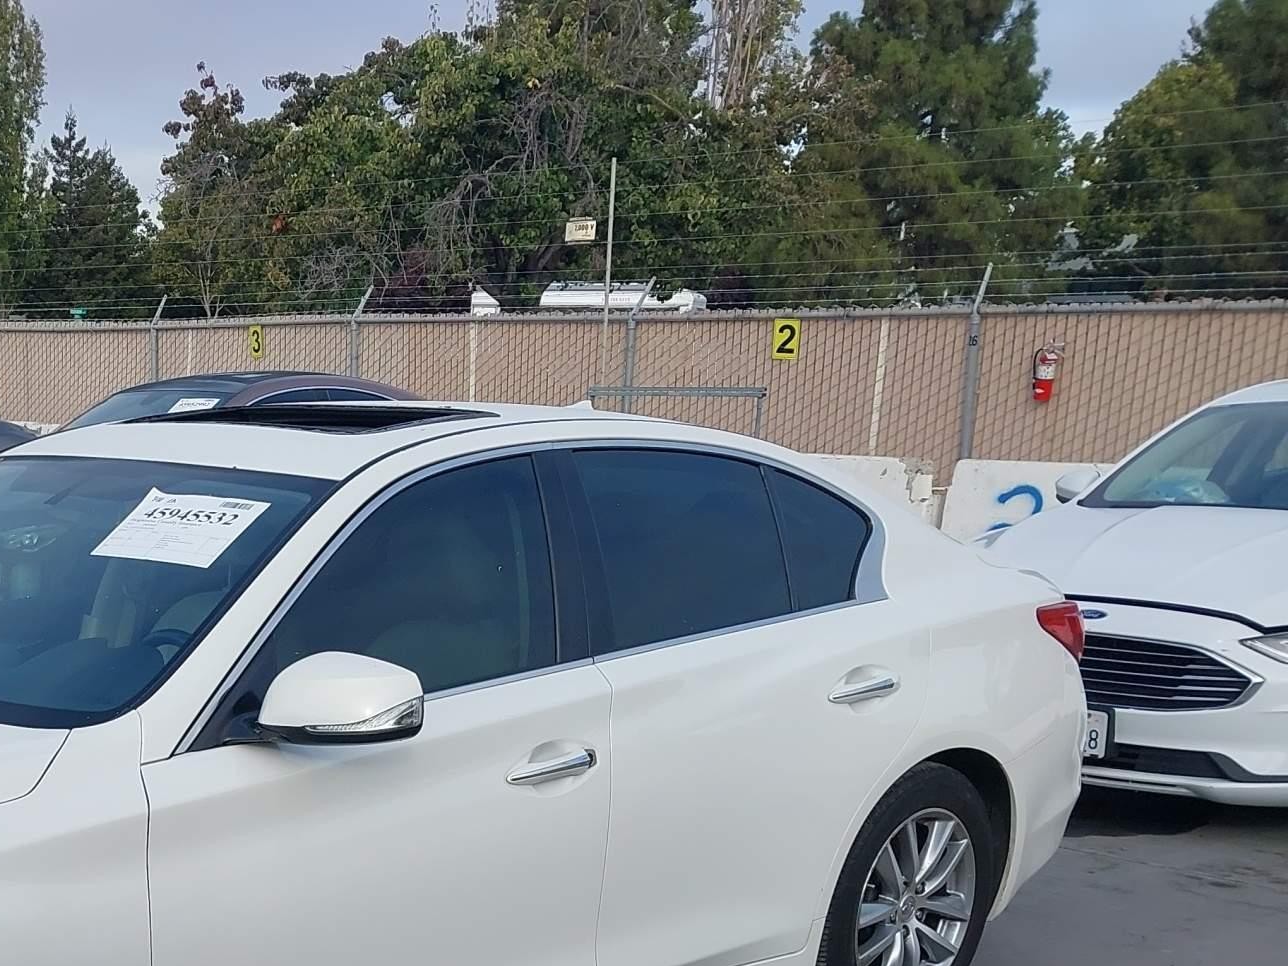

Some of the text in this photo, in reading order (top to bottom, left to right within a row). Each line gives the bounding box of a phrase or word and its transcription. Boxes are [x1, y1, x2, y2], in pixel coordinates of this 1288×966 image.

[252, 329, 261, 353] 3
[776, 324, 796, 354] 2
[144, 507, 239, 526] 45945532
